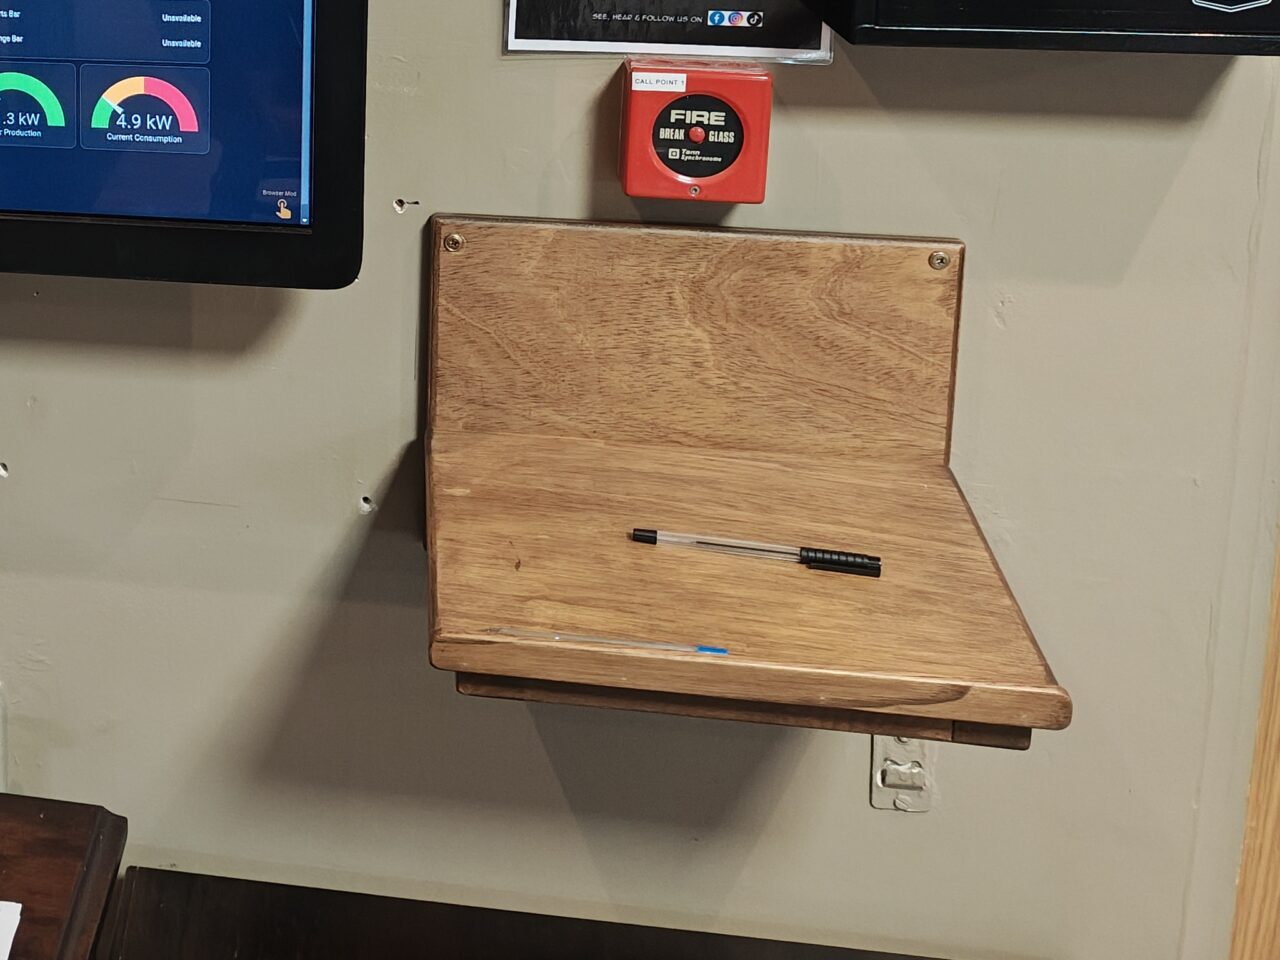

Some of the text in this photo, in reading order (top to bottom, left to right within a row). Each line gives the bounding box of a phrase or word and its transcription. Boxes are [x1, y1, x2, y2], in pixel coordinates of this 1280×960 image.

[19, 112, 40, 126] kW
[116, 113, 172, 131] 4.9 kW
[670, 110, 726, 125] FIRE
[659, 128, 734, 143] BREAK GLASS
